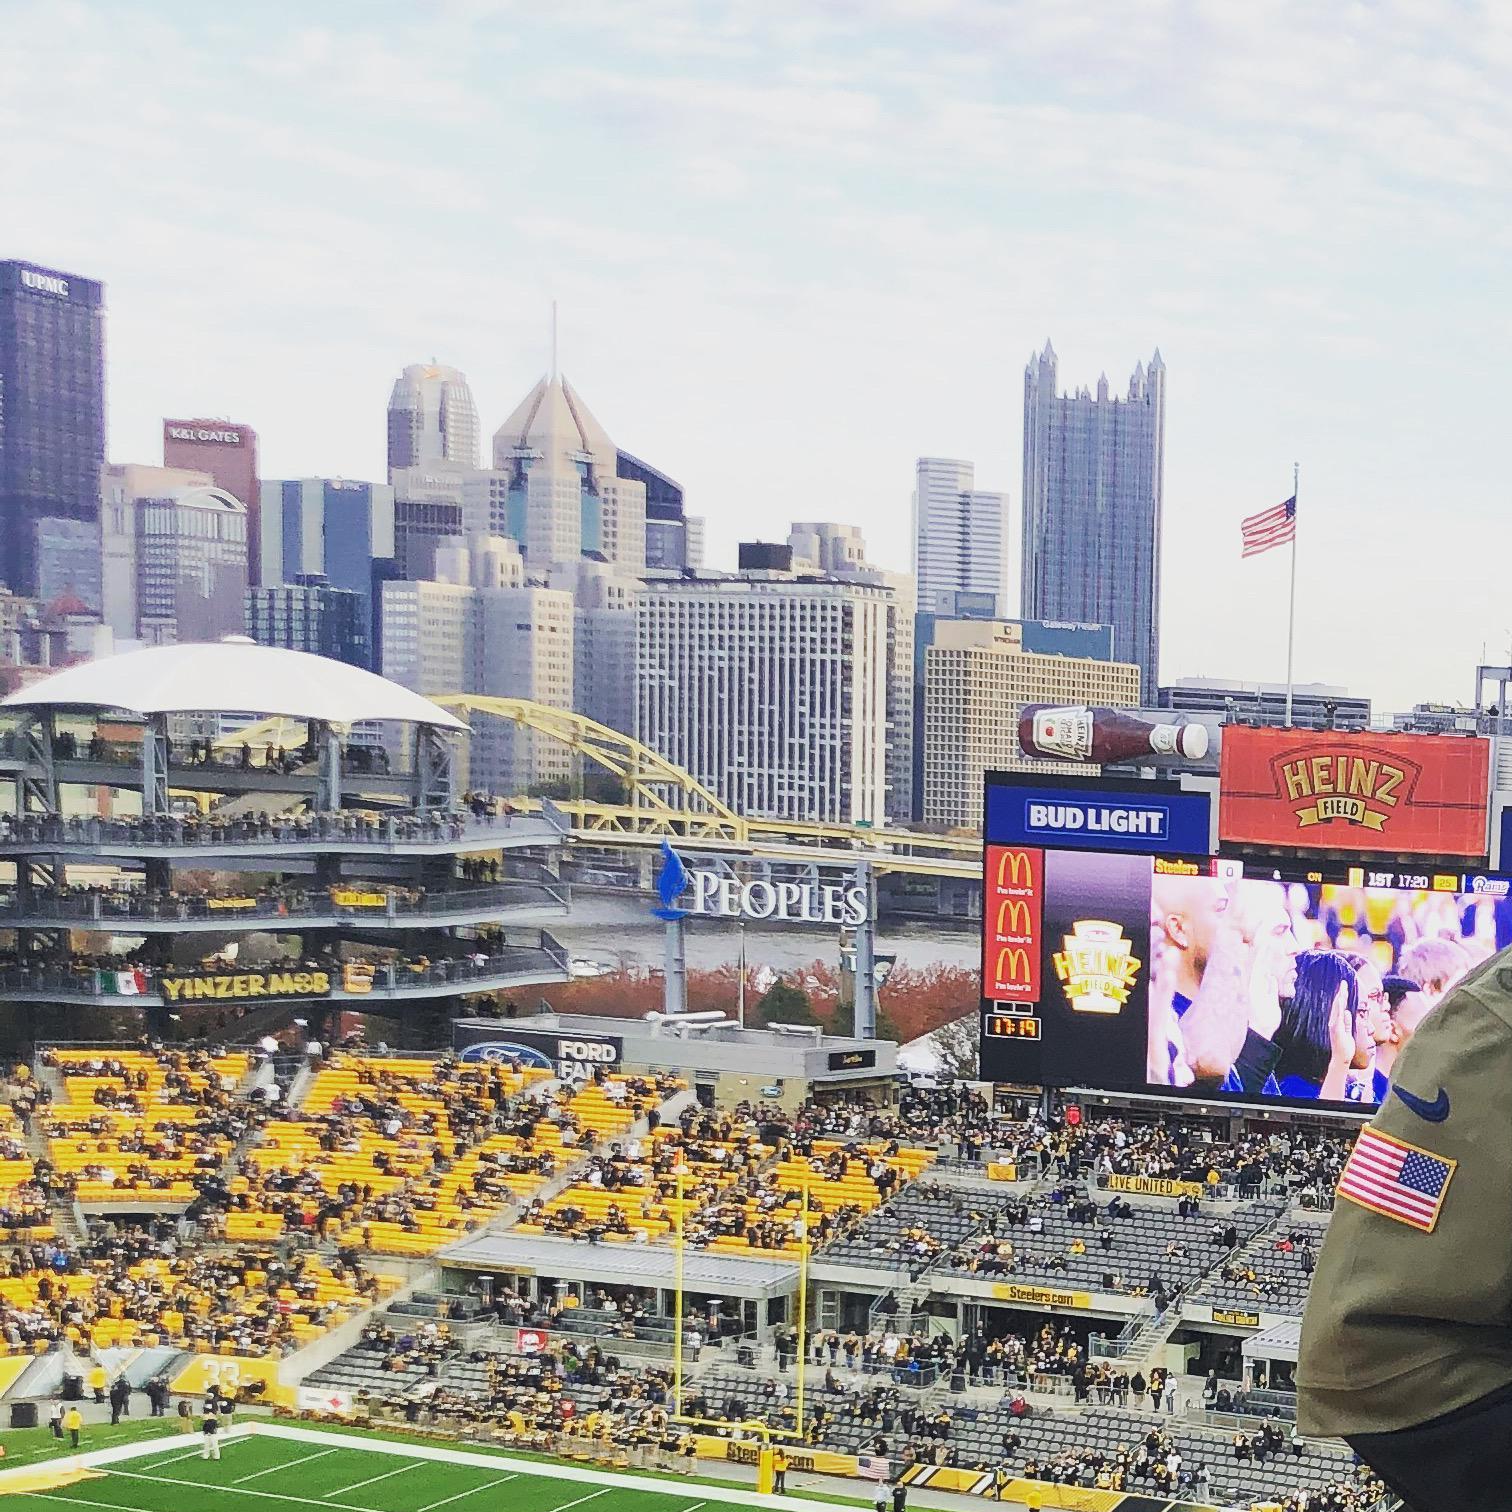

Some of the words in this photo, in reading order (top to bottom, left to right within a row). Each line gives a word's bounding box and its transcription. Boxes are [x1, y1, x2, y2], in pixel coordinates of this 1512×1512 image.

[21, 269, 69, 297] UPMC
[198, 430, 240, 443] GATES
[1282, 755, 1406, 808] HEINZ
[1029, 804, 1085, 830] BUD
[1087, 808, 1164, 834] LIGHT
[1322, 799, 1360, 818] FIELD
[1155, 858, 1199, 876] Steelers
[1368, 872, 1394, 887] 1ST
[1399, 874, 1429, 889] 17:20
[693, 870, 868, 926] PEOPLES
[1052, 950, 1142, 987] HEINZ
[161, 974, 267, 1000] YINZER
[994, 1018, 1037, 1037] 17:19
[558, 1039, 617, 1062] FORD
[1108, 1173, 1131, 1189] LIVE
[1134, 1177, 1173, 1194] UNITED
[1009, 1285, 1074, 1307] Steelers.com
